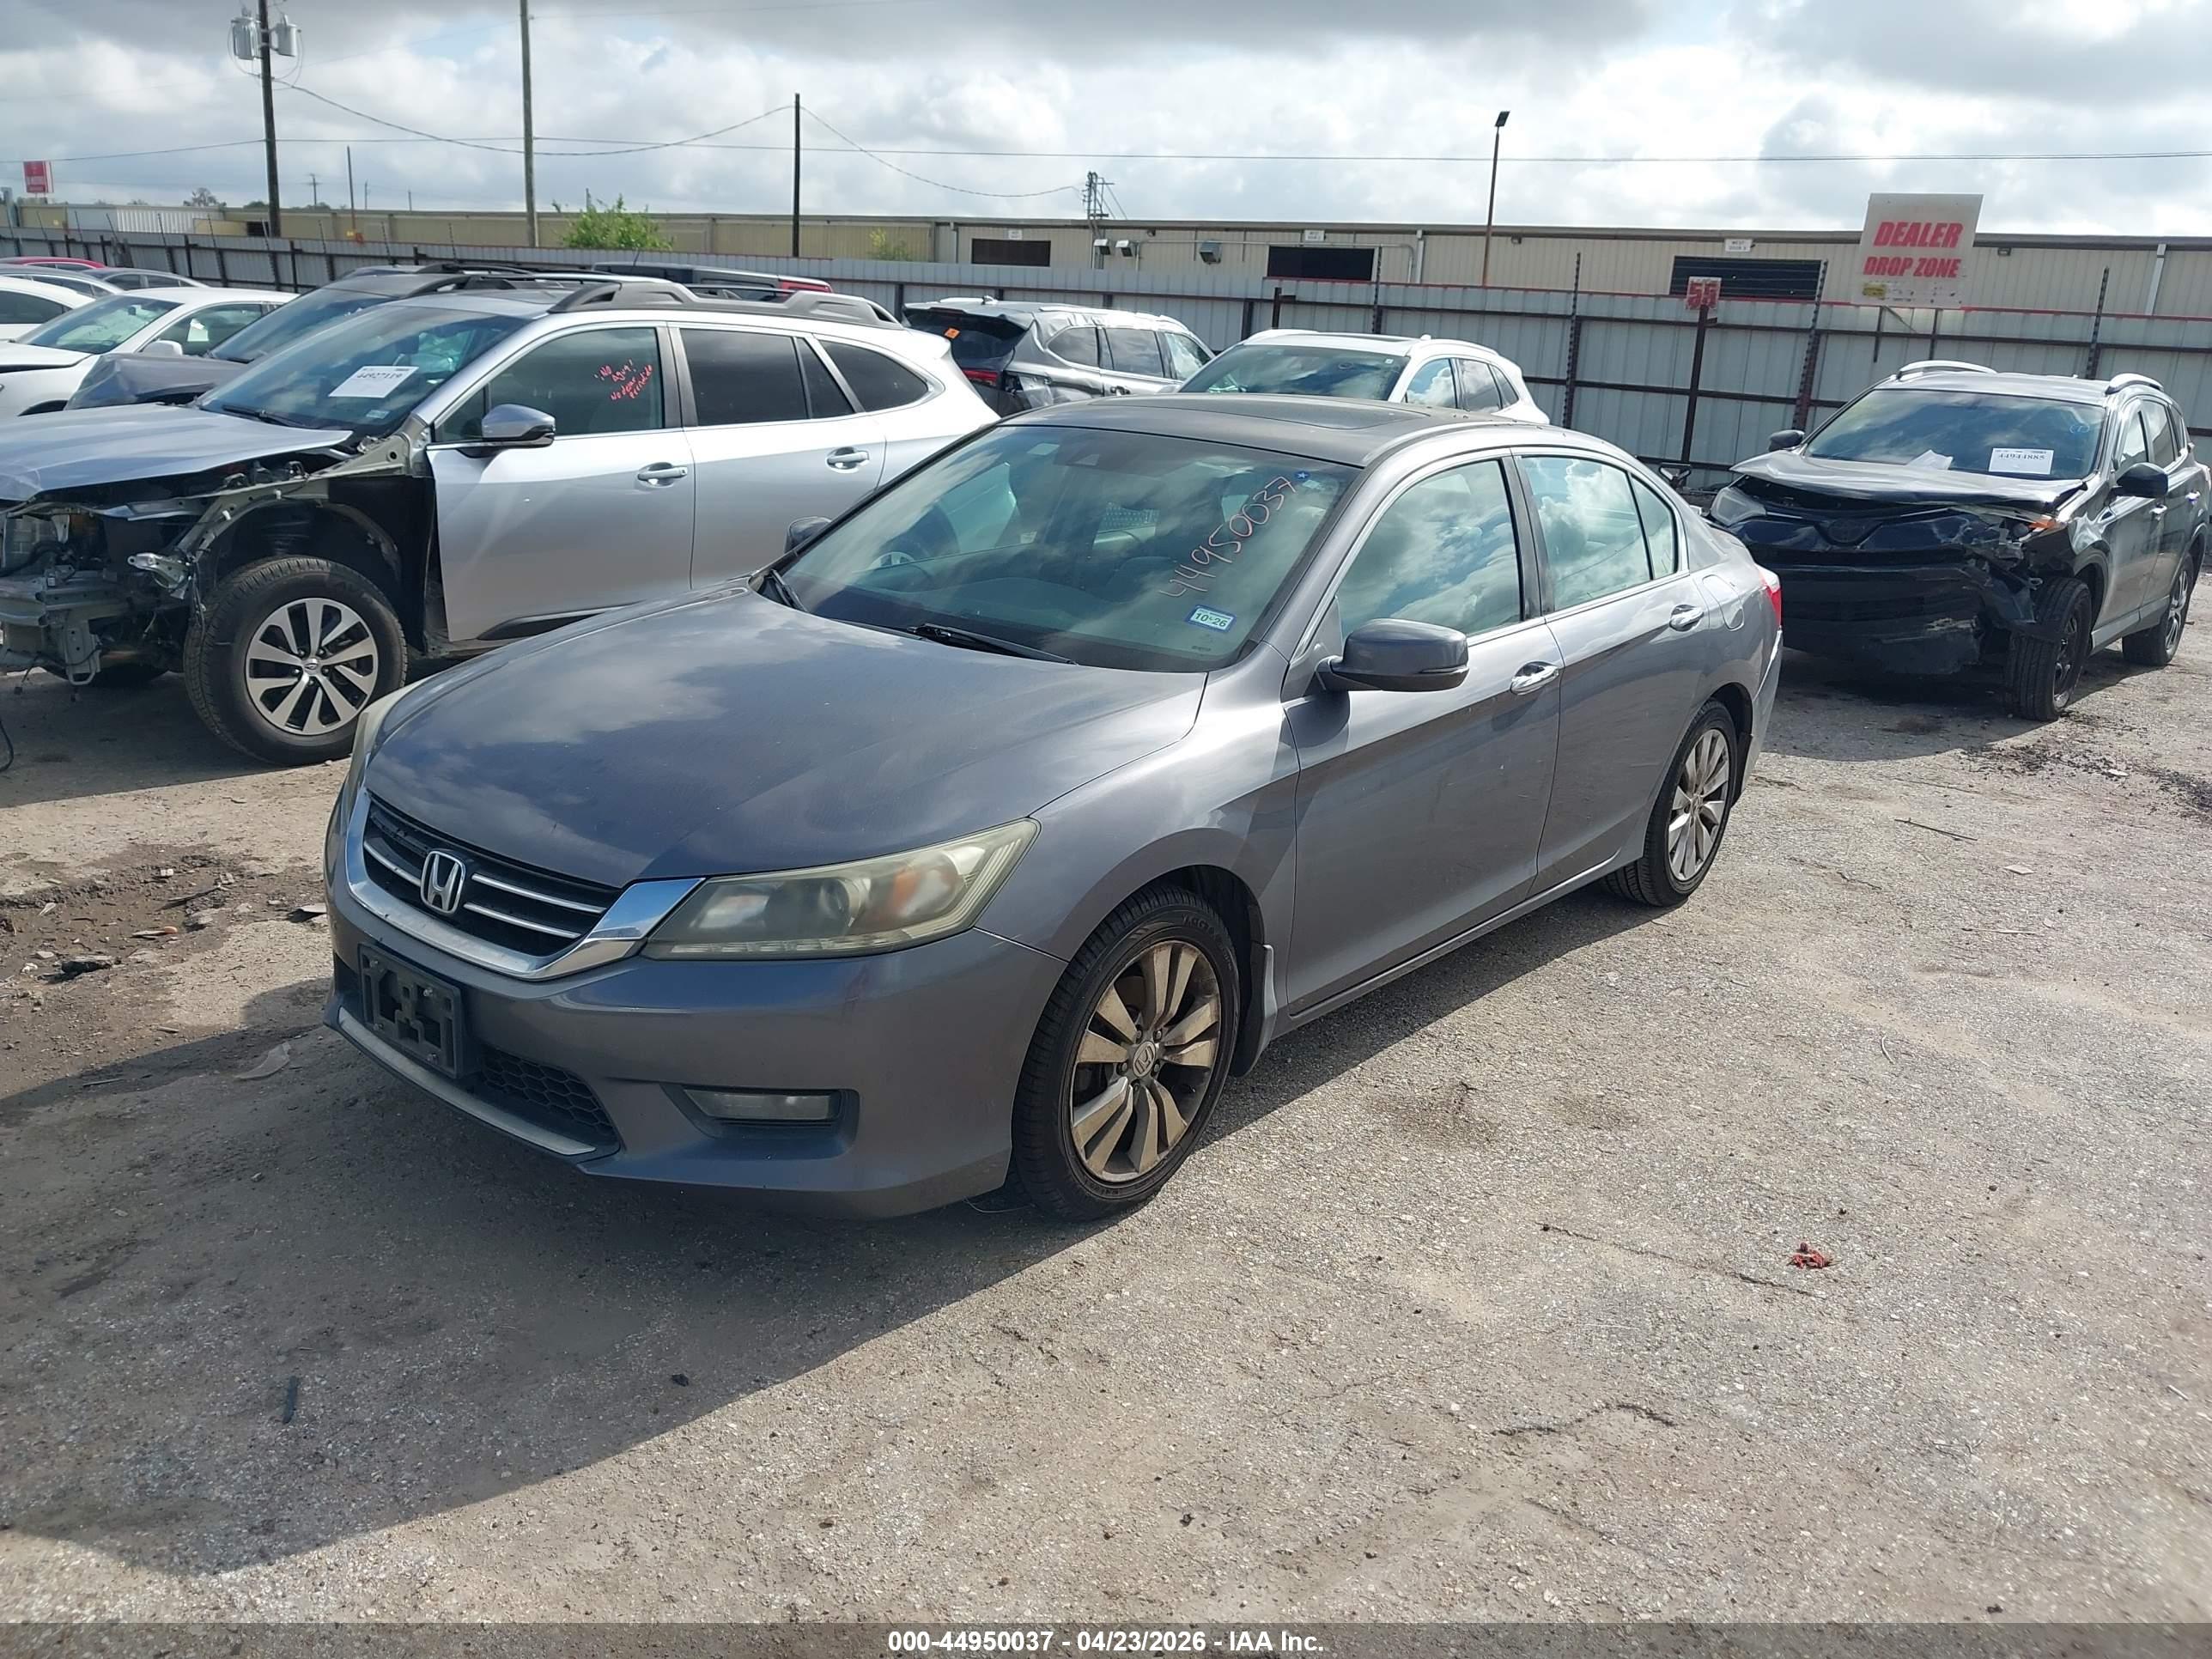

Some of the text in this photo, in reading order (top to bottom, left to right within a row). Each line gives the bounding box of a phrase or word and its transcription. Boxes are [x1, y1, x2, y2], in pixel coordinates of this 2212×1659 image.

[1873, 221, 1964, 248] DEALER
[1863, 256, 1962, 278] DROP ZONE
[1158, 476, 1297, 598] 44950037
